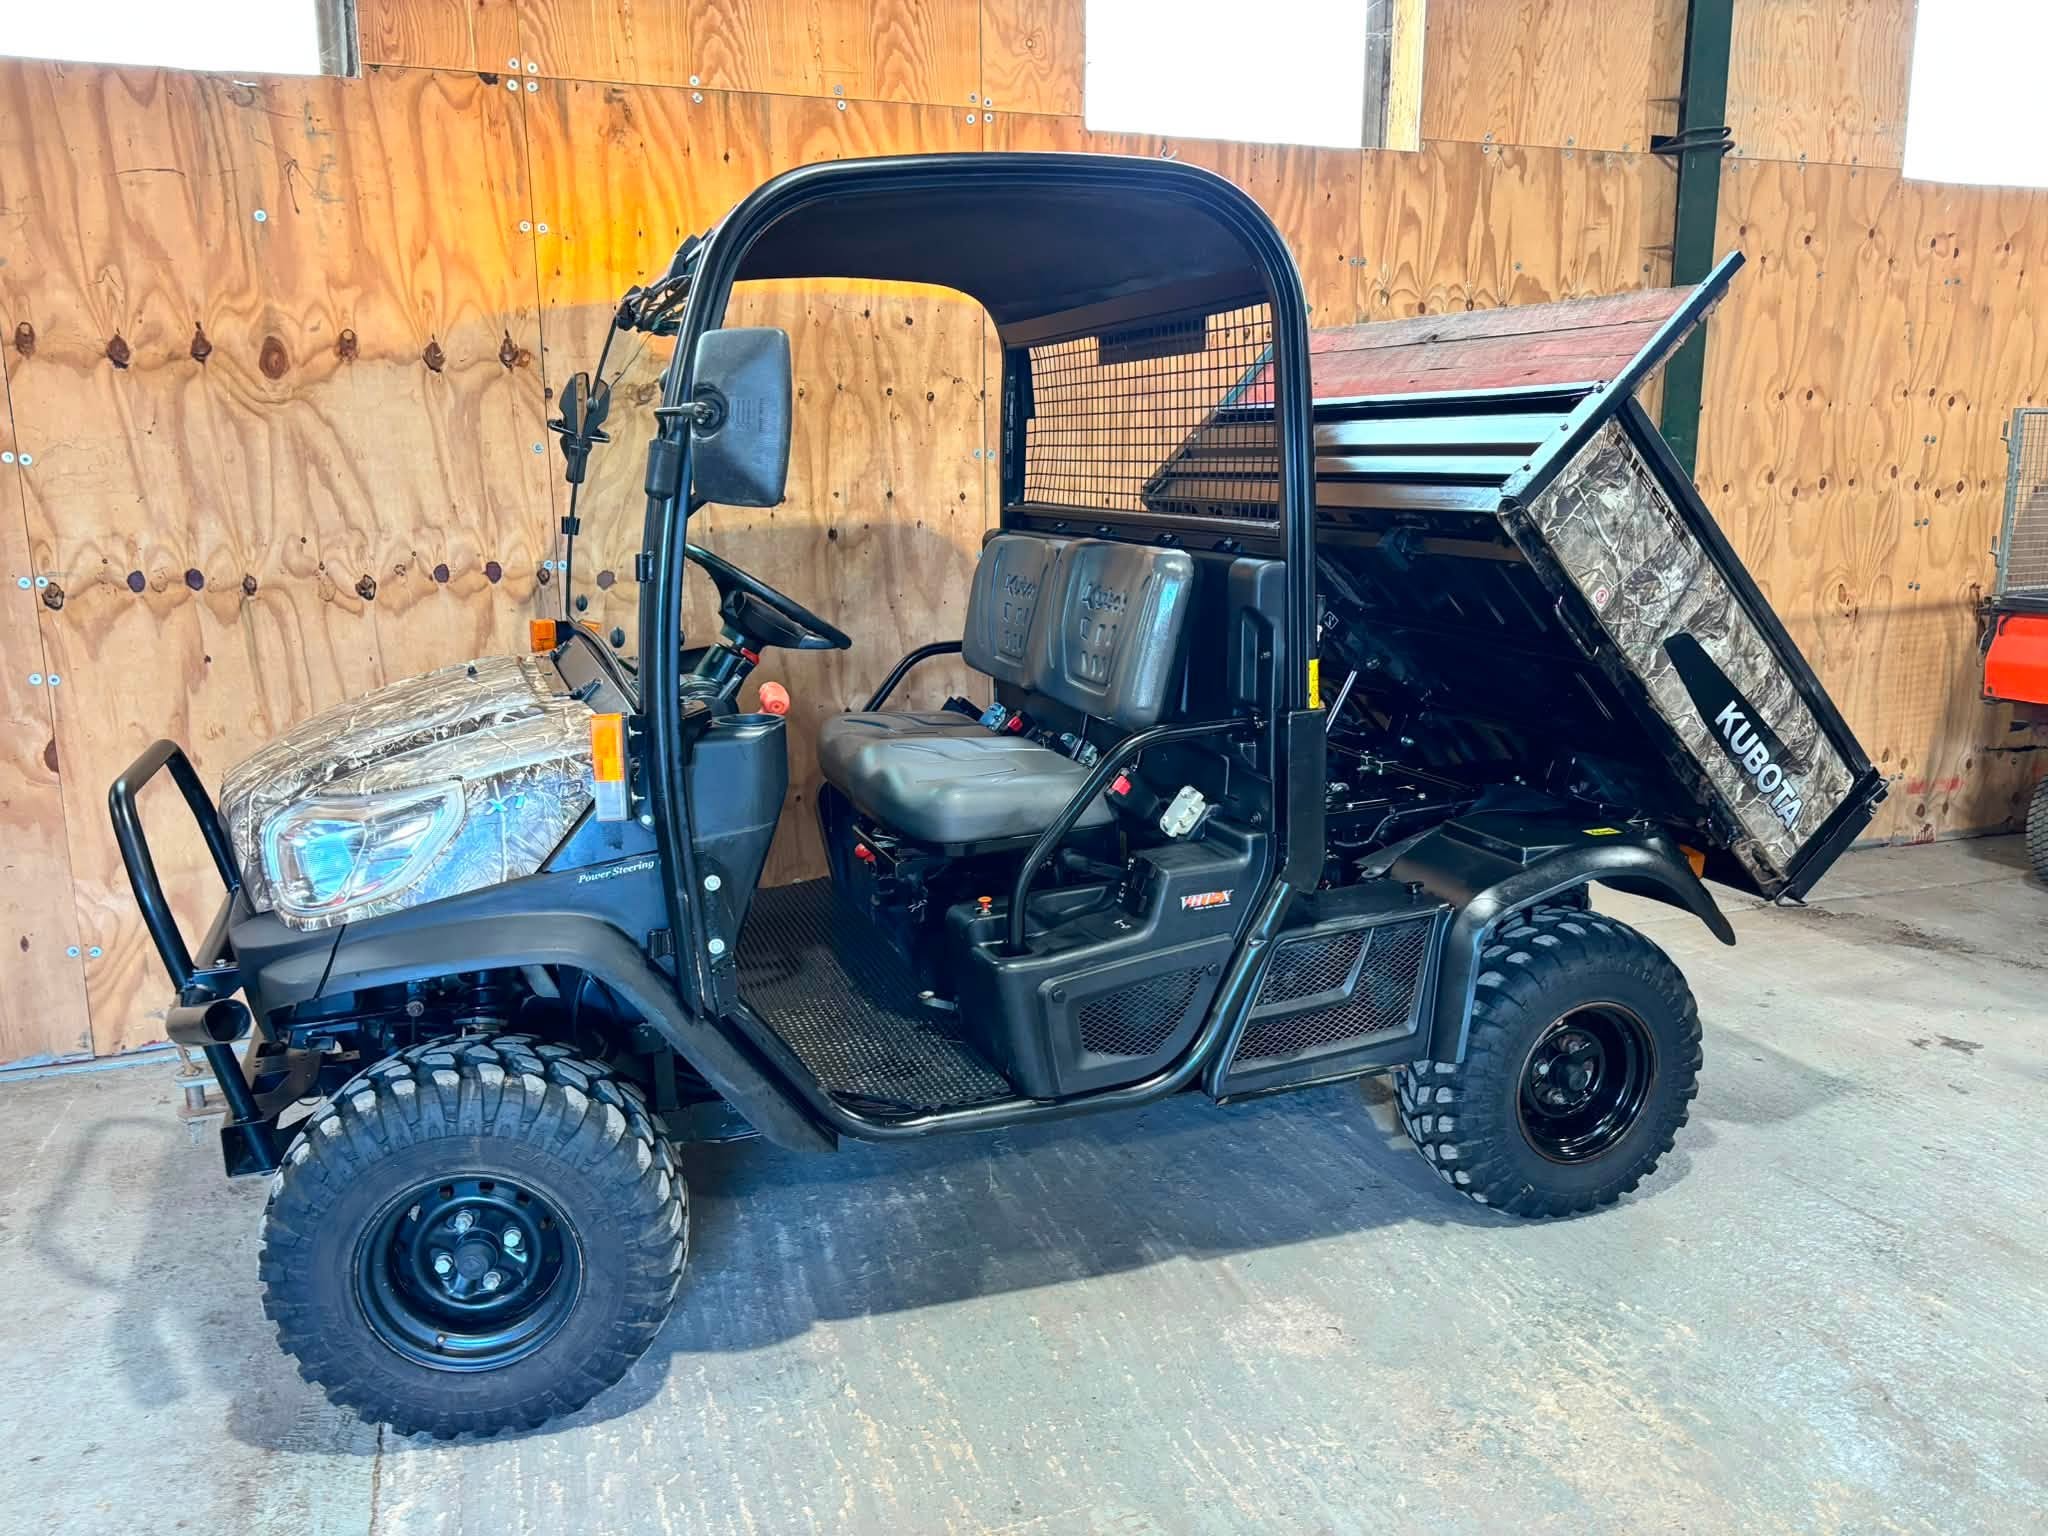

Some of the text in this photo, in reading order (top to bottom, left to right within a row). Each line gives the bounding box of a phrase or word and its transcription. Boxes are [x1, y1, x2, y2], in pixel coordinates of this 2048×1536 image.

[1614, 434, 1692, 556] DIESEL
[1714, 700, 1803, 832] KUBOTA
[578, 860, 655, 884] Power Steering
